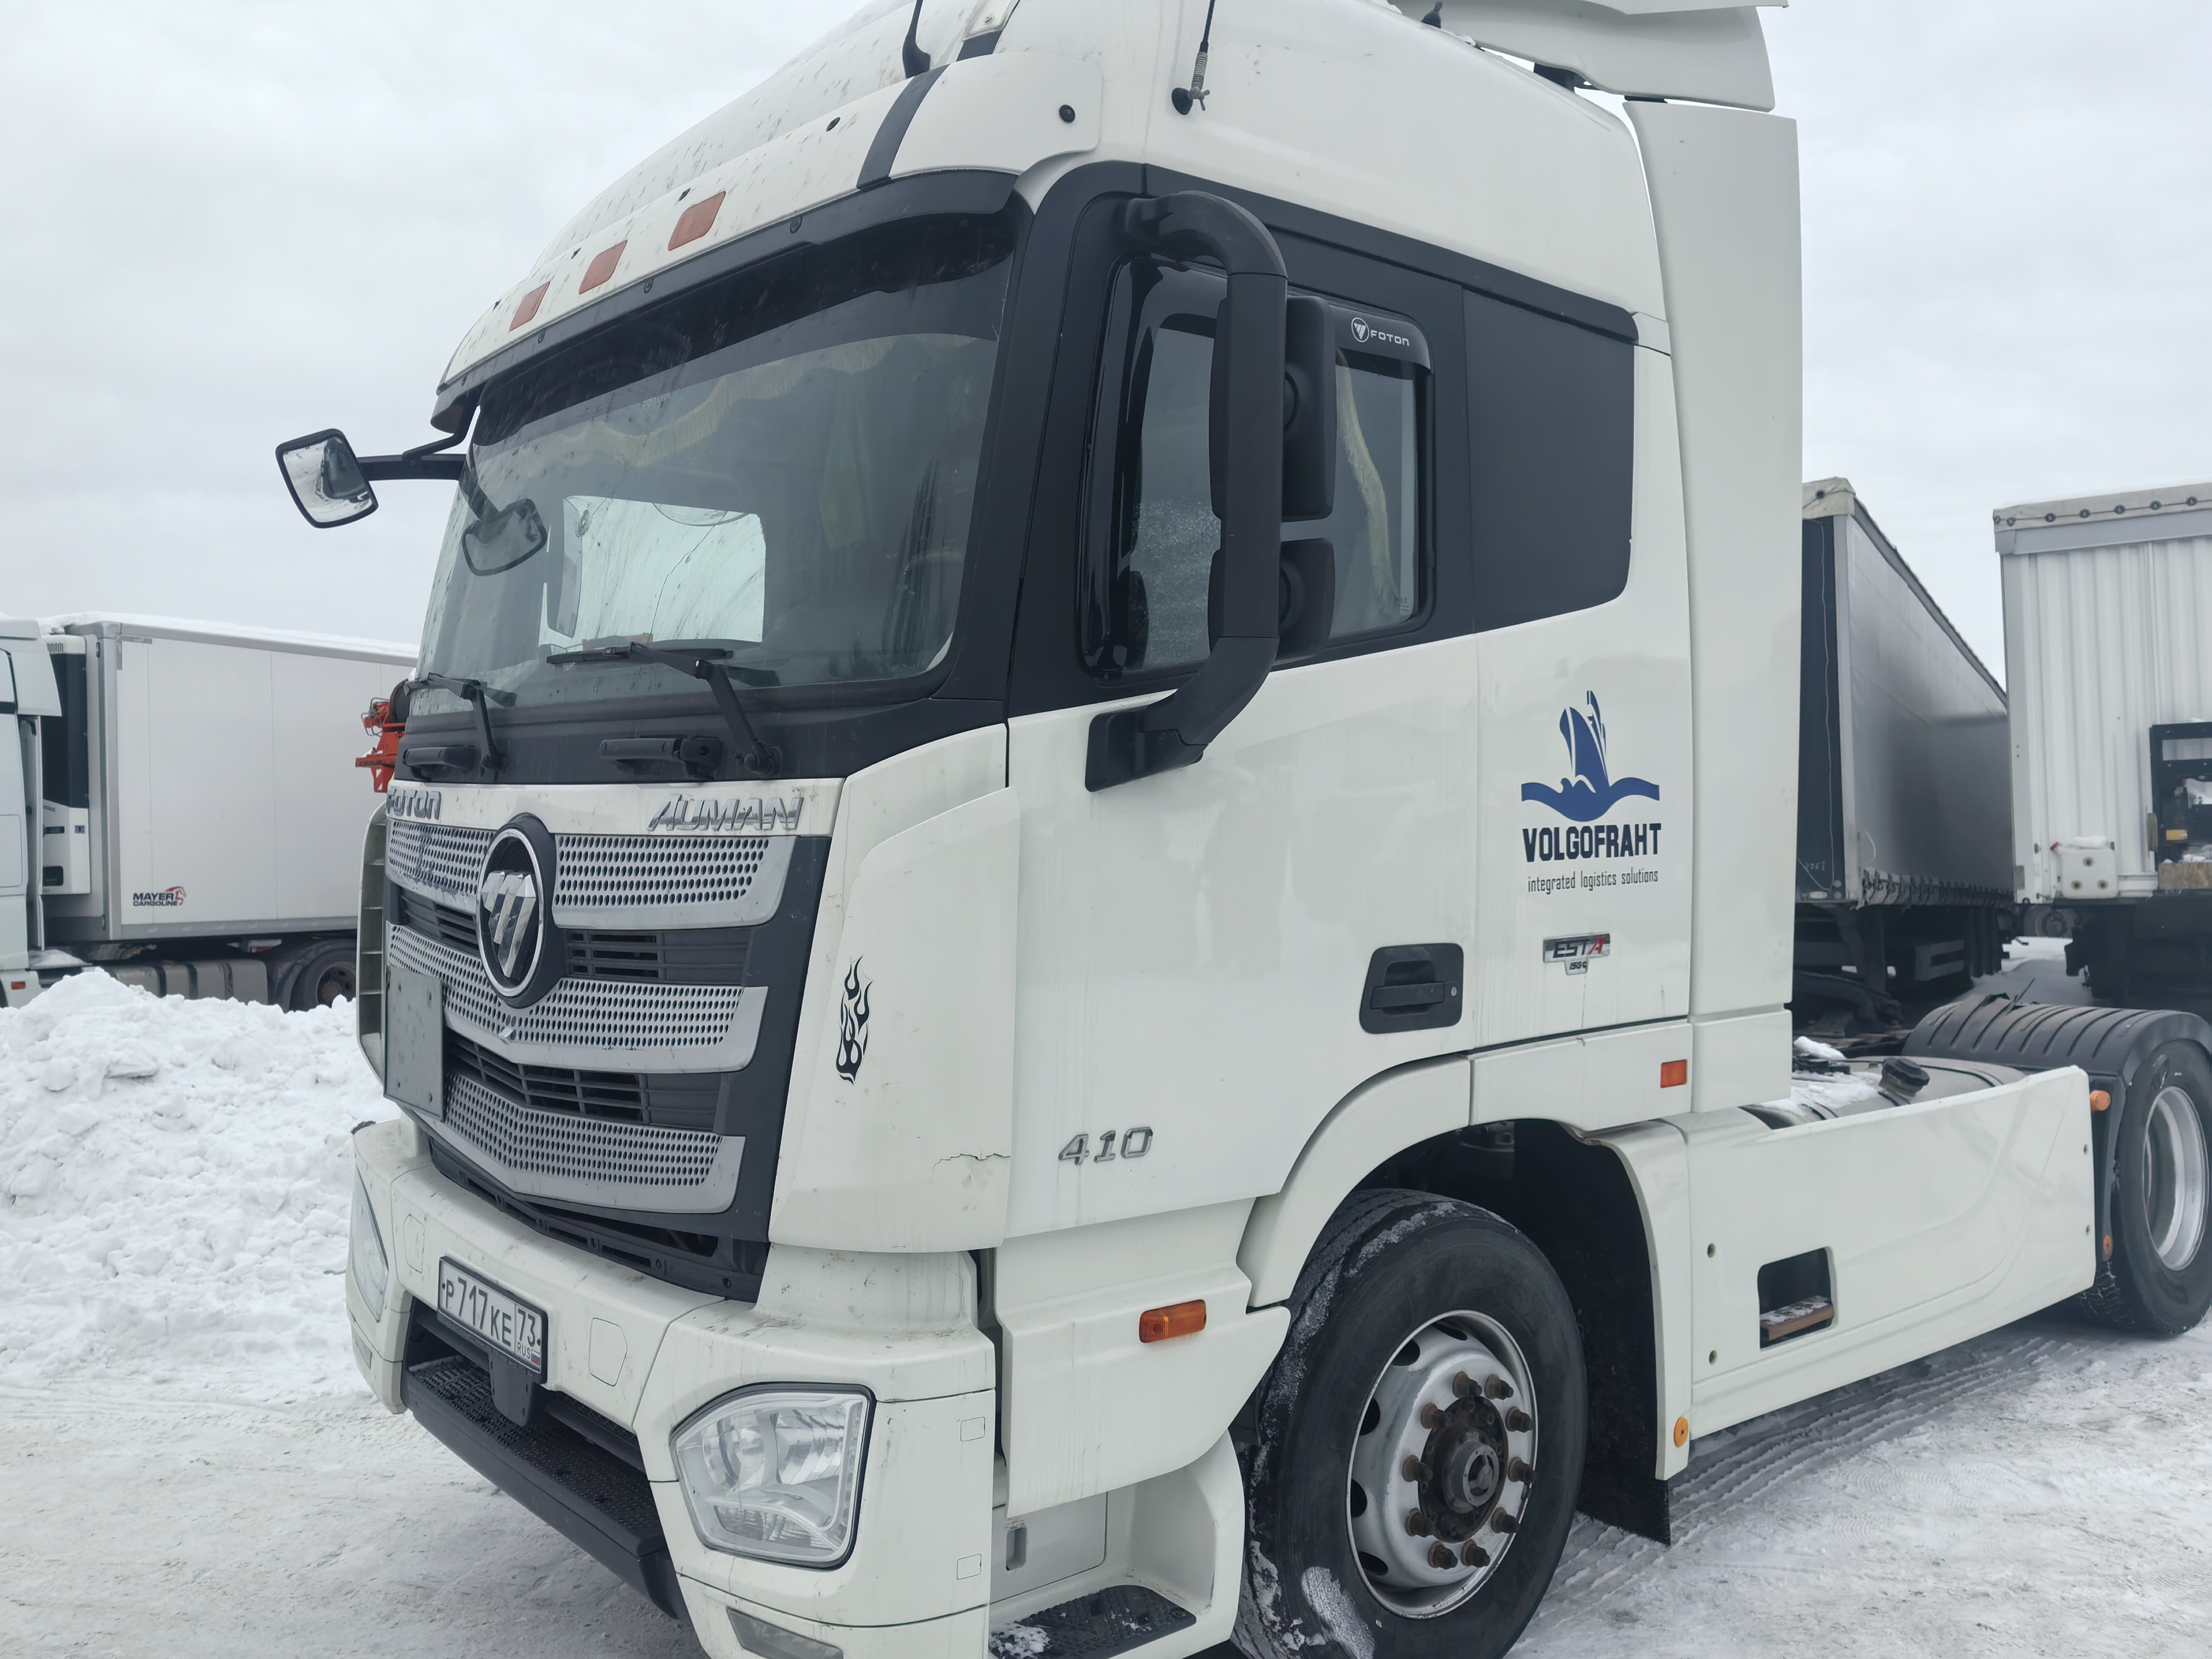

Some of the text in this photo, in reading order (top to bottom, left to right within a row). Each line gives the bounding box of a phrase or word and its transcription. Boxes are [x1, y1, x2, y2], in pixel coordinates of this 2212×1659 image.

[1370, 329, 1410, 347] FOTON
[386, 788, 442, 820] FOTON
[646, 794, 804, 831] AUMAN
[1522, 822, 1662, 862] VOLGOFRAHT
[1528, 866, 1658, 895] integrated logistics solutions
[133, 893, 174, 901] MAYER
[1058, 1127, 1154, 1165] 410
[517, 1341, 531, 1360] RUS
